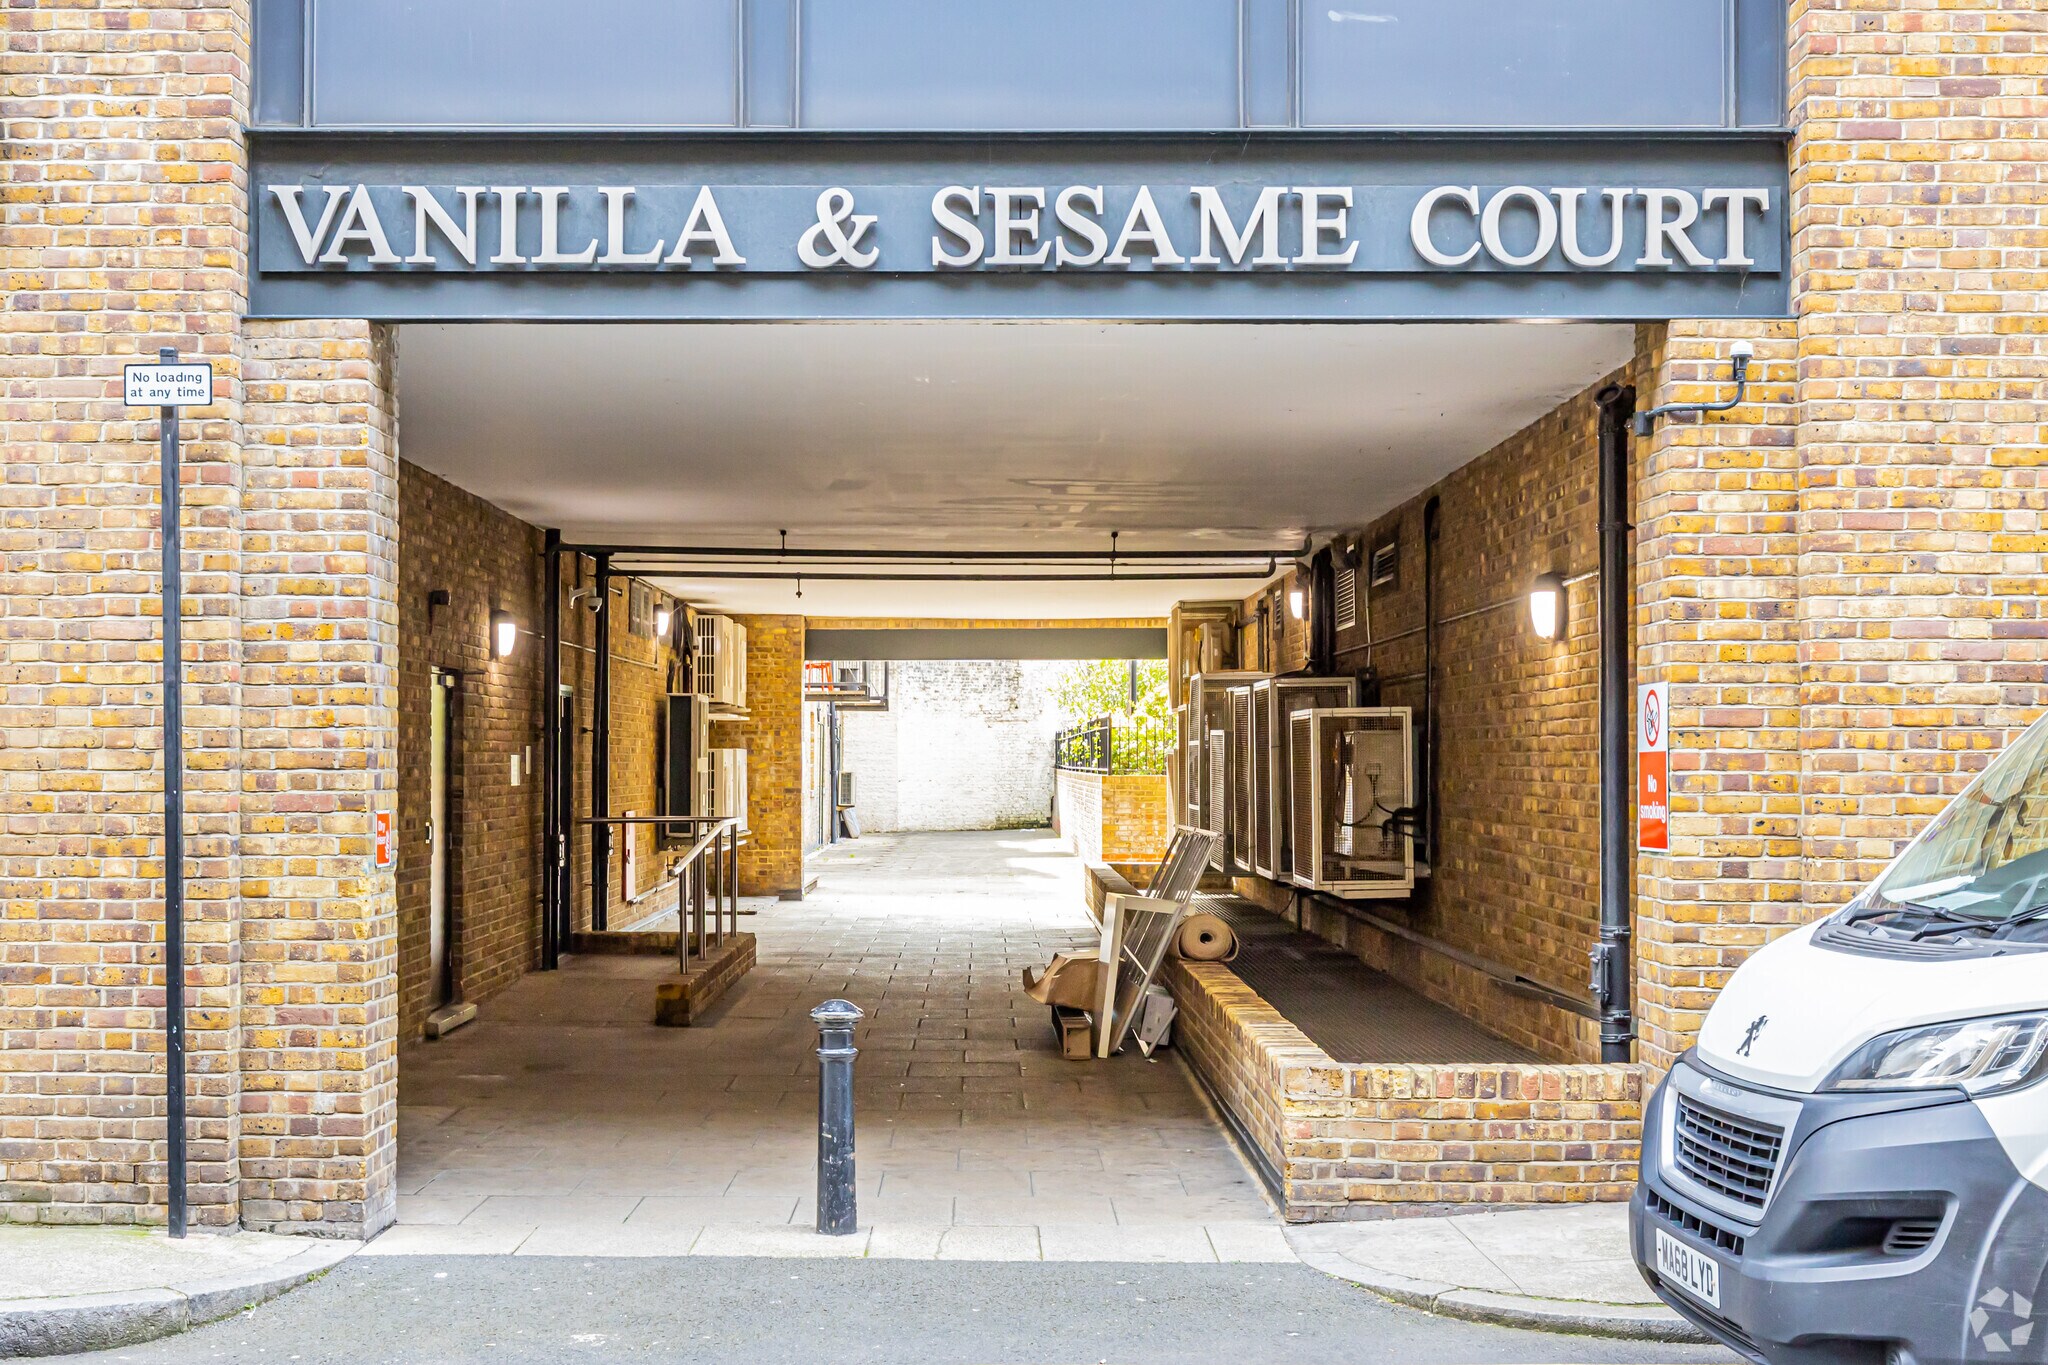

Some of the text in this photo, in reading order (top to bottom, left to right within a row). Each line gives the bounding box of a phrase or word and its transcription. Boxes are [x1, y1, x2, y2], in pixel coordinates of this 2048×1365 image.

[267, 184, 1771, 269] VANILLA & SESAME COURT
[132, 372, 202, 384] No loading
[130, 386, 205, 399] at any time
[1647, 774, 1657, 793] No
[1640, 801, 1666, 824] smoking
[1661, 1235, 1714, 1298] MA68 LYD
